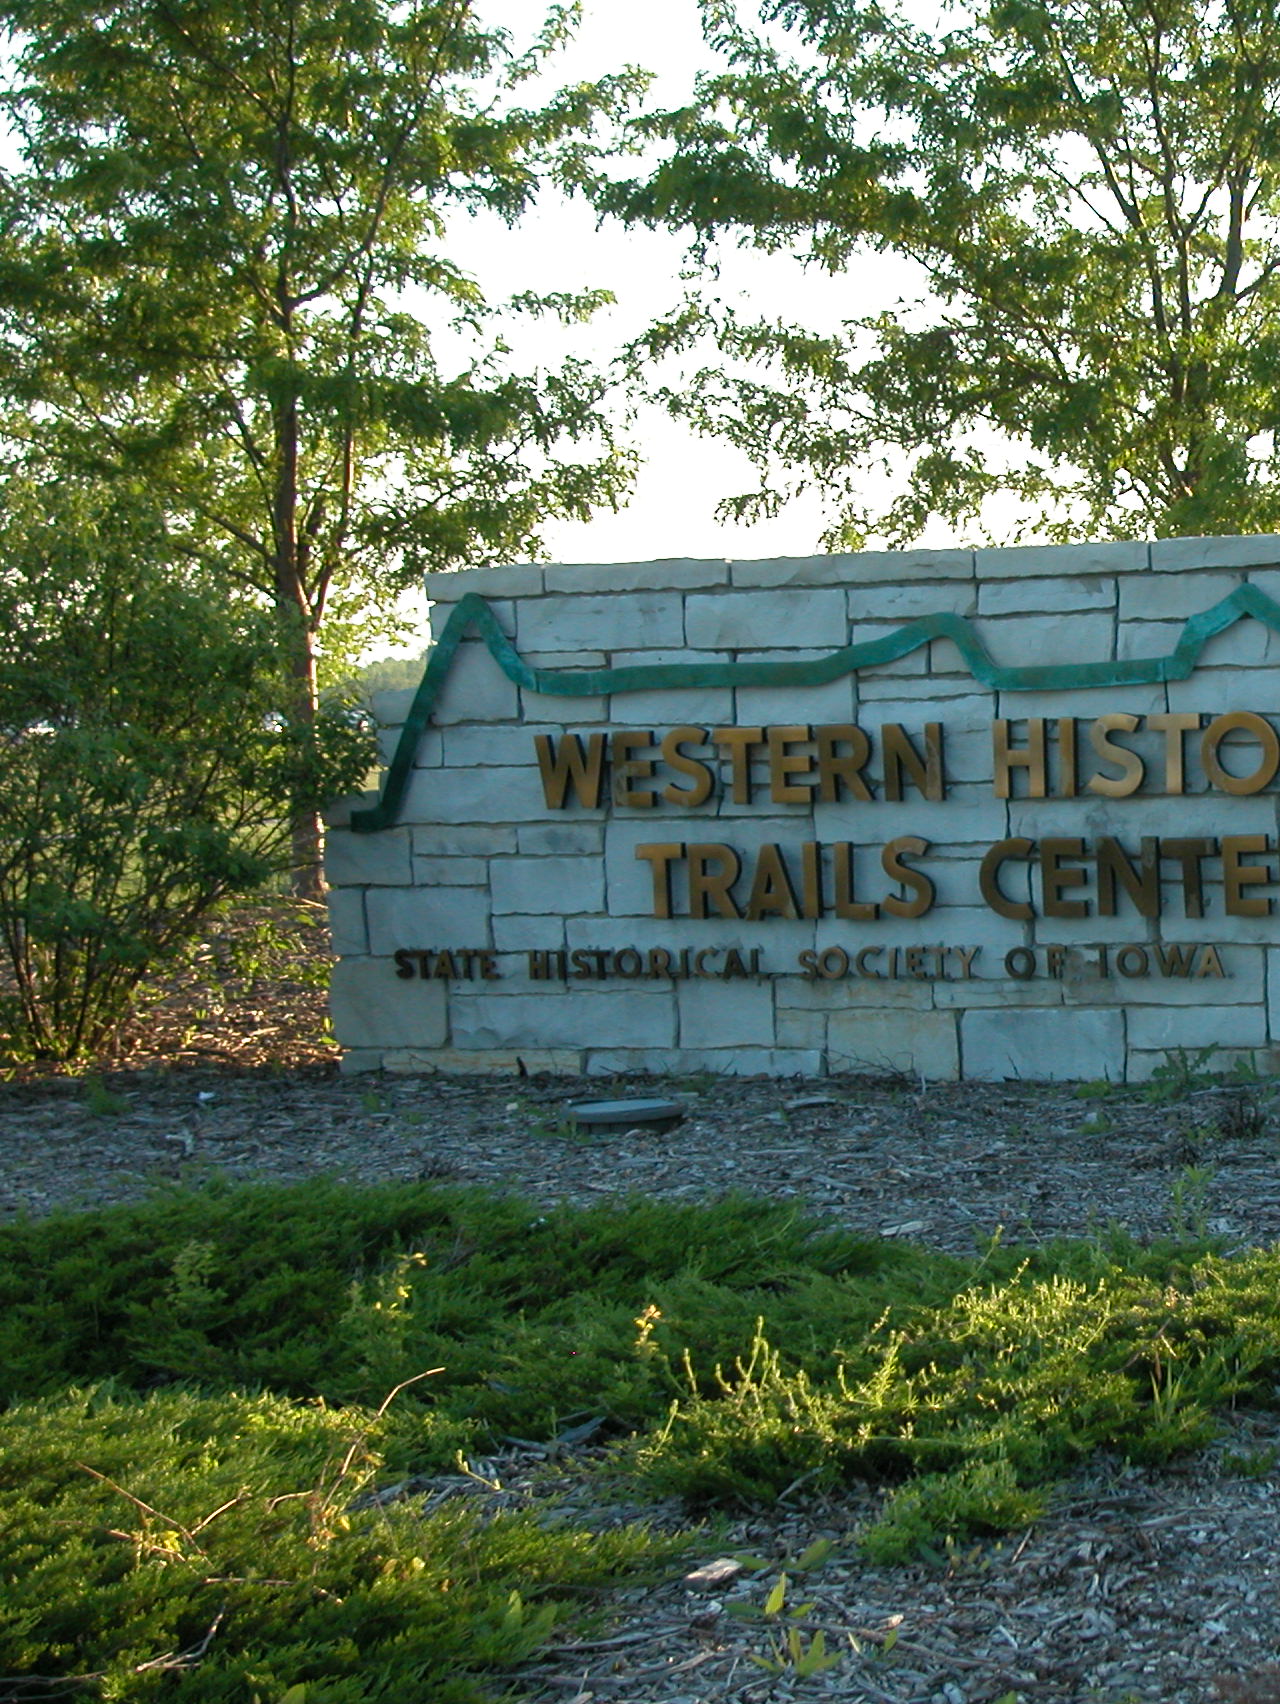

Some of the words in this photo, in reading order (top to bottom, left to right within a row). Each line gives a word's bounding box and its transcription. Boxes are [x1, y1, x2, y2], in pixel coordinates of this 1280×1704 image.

[533, 721, 946, 810] WESTERN
[634, 835, 936, 921] TRAILS
[394, 947, 500, 981] STATE
[528, 946, 764, 982] HISTORICAL
[799, 945, 983, 980] SOCIETY
[1004, 945, 1068, 980] OF
[1099, 944, 1228, 979] IOWA
